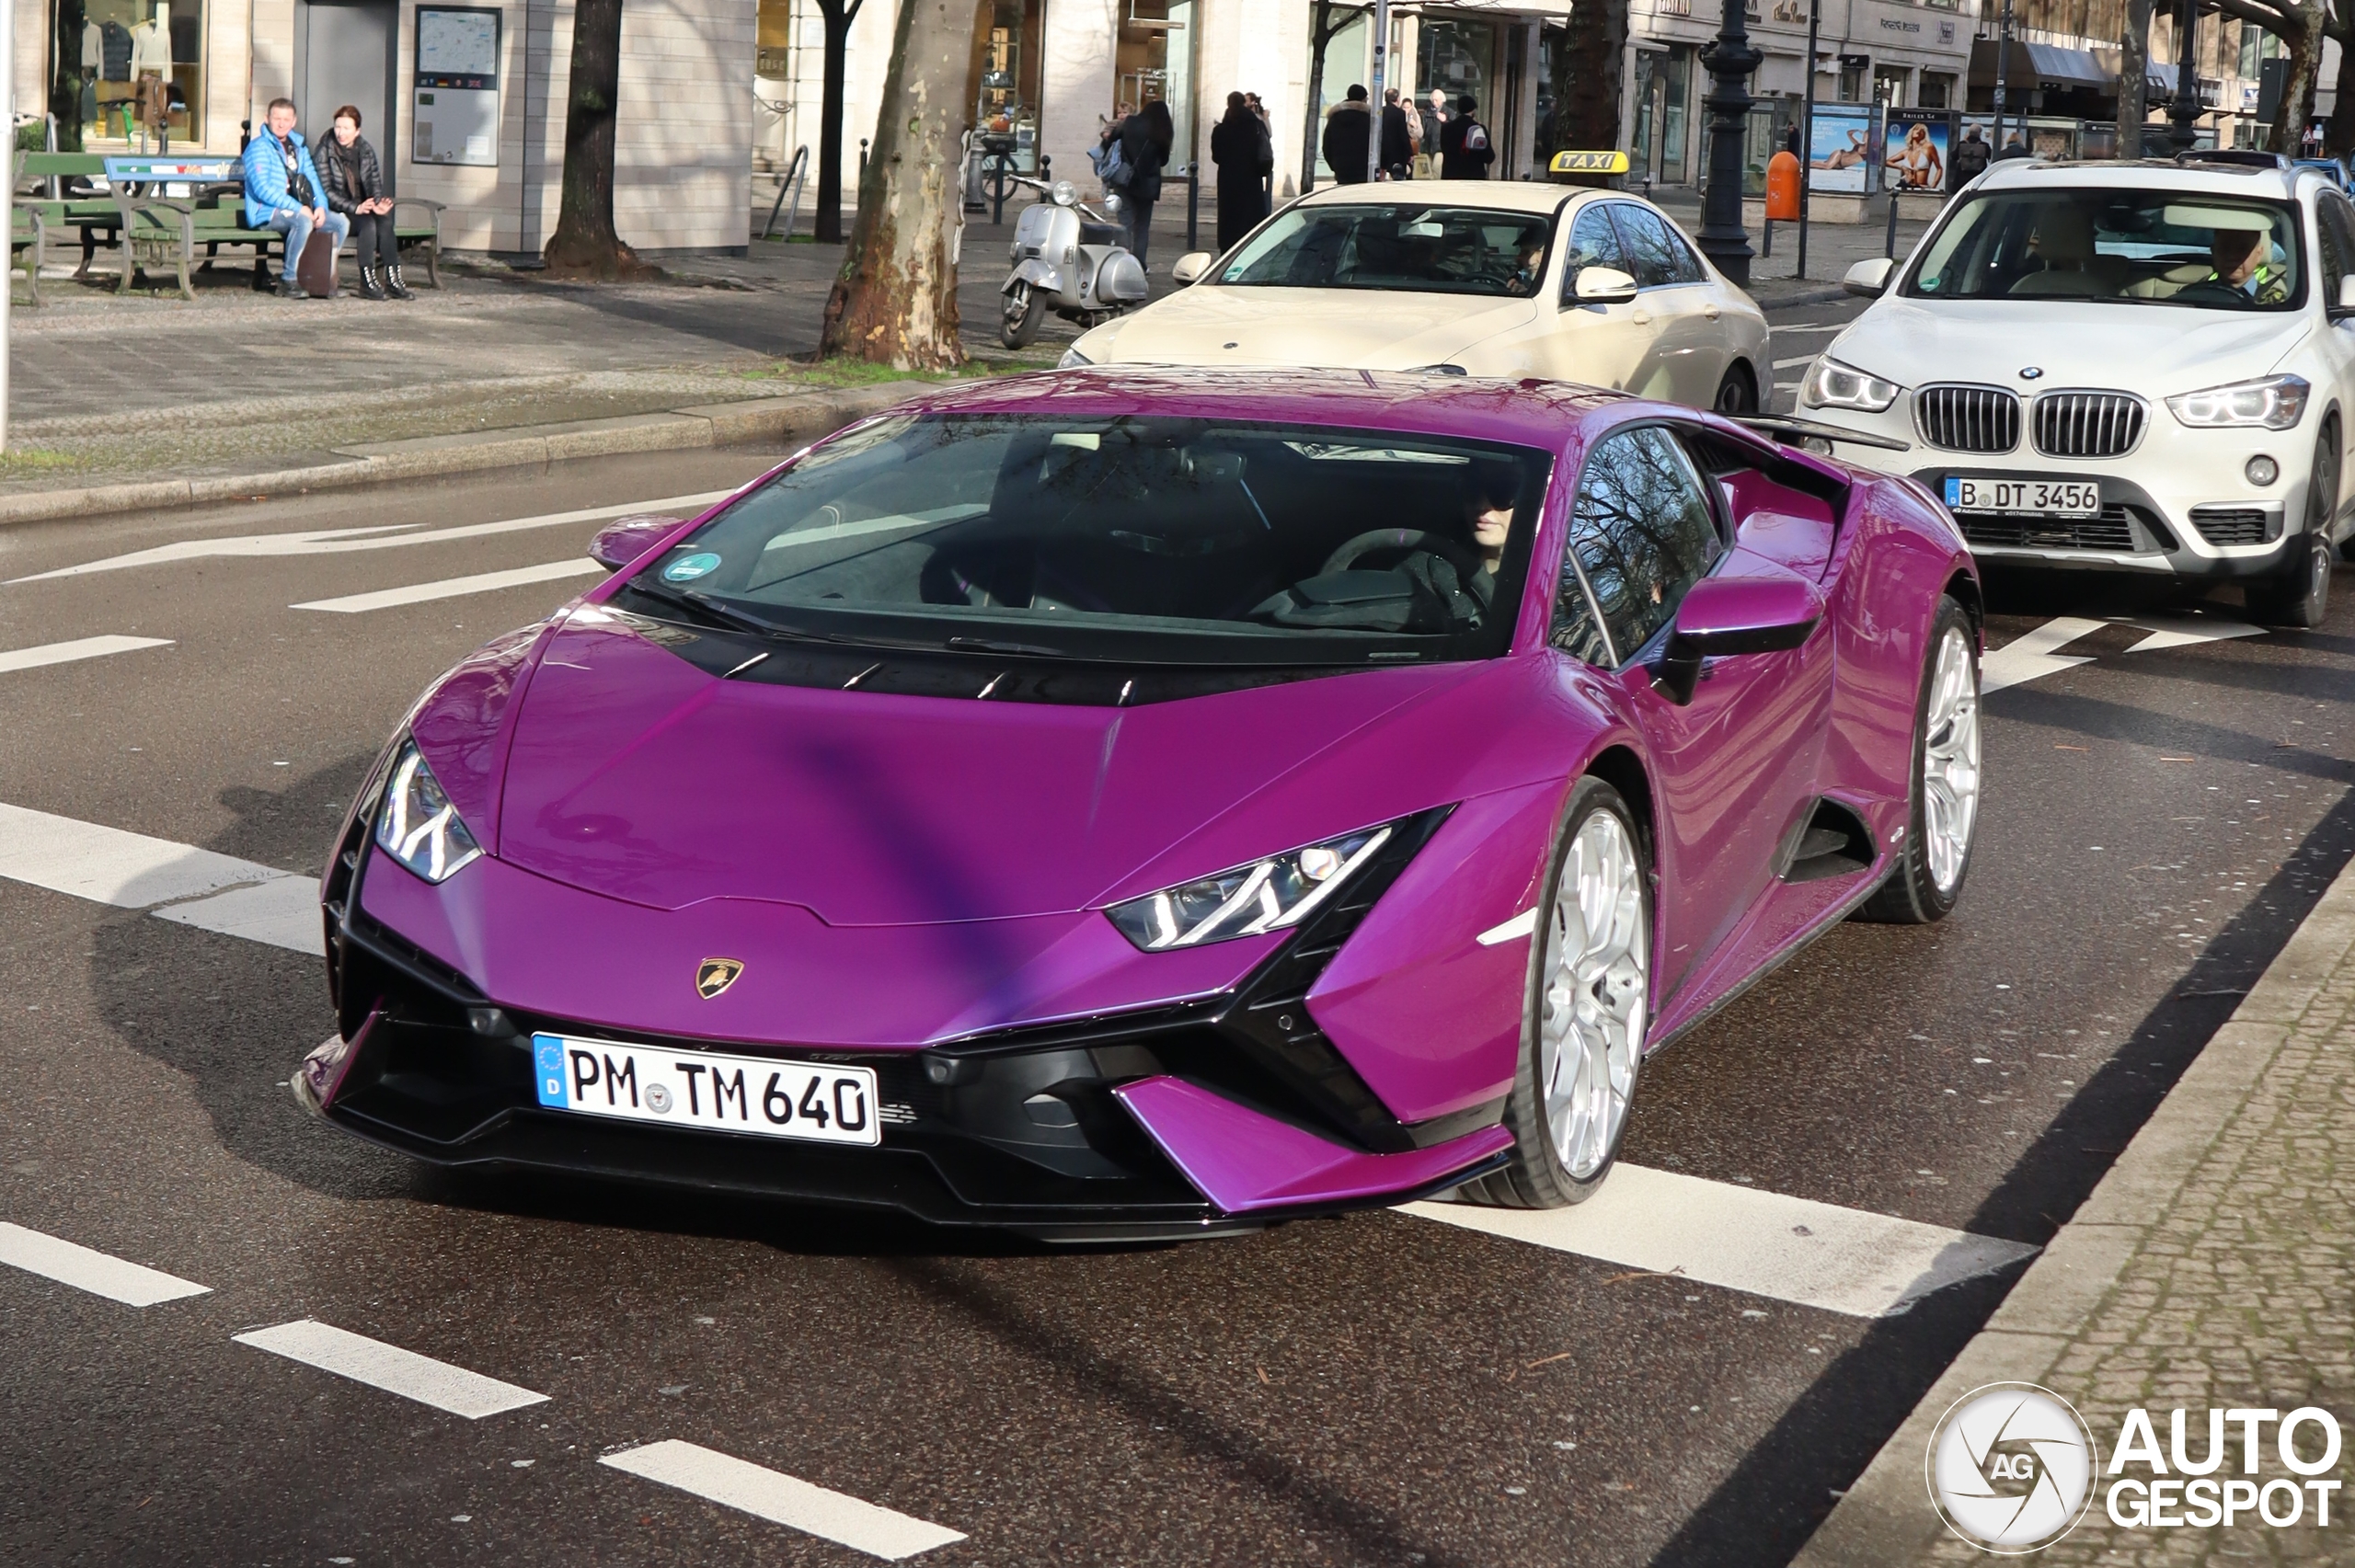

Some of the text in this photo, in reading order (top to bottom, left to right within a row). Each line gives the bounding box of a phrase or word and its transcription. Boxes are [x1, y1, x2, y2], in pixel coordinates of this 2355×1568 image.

[1563, 155, 1614, 167] TAXI
[1961, 483, 2097, 509] B DT 3456
[546, 1078, 560, 1095] D
[569, 1049, 867, 1132] PM TM 640
